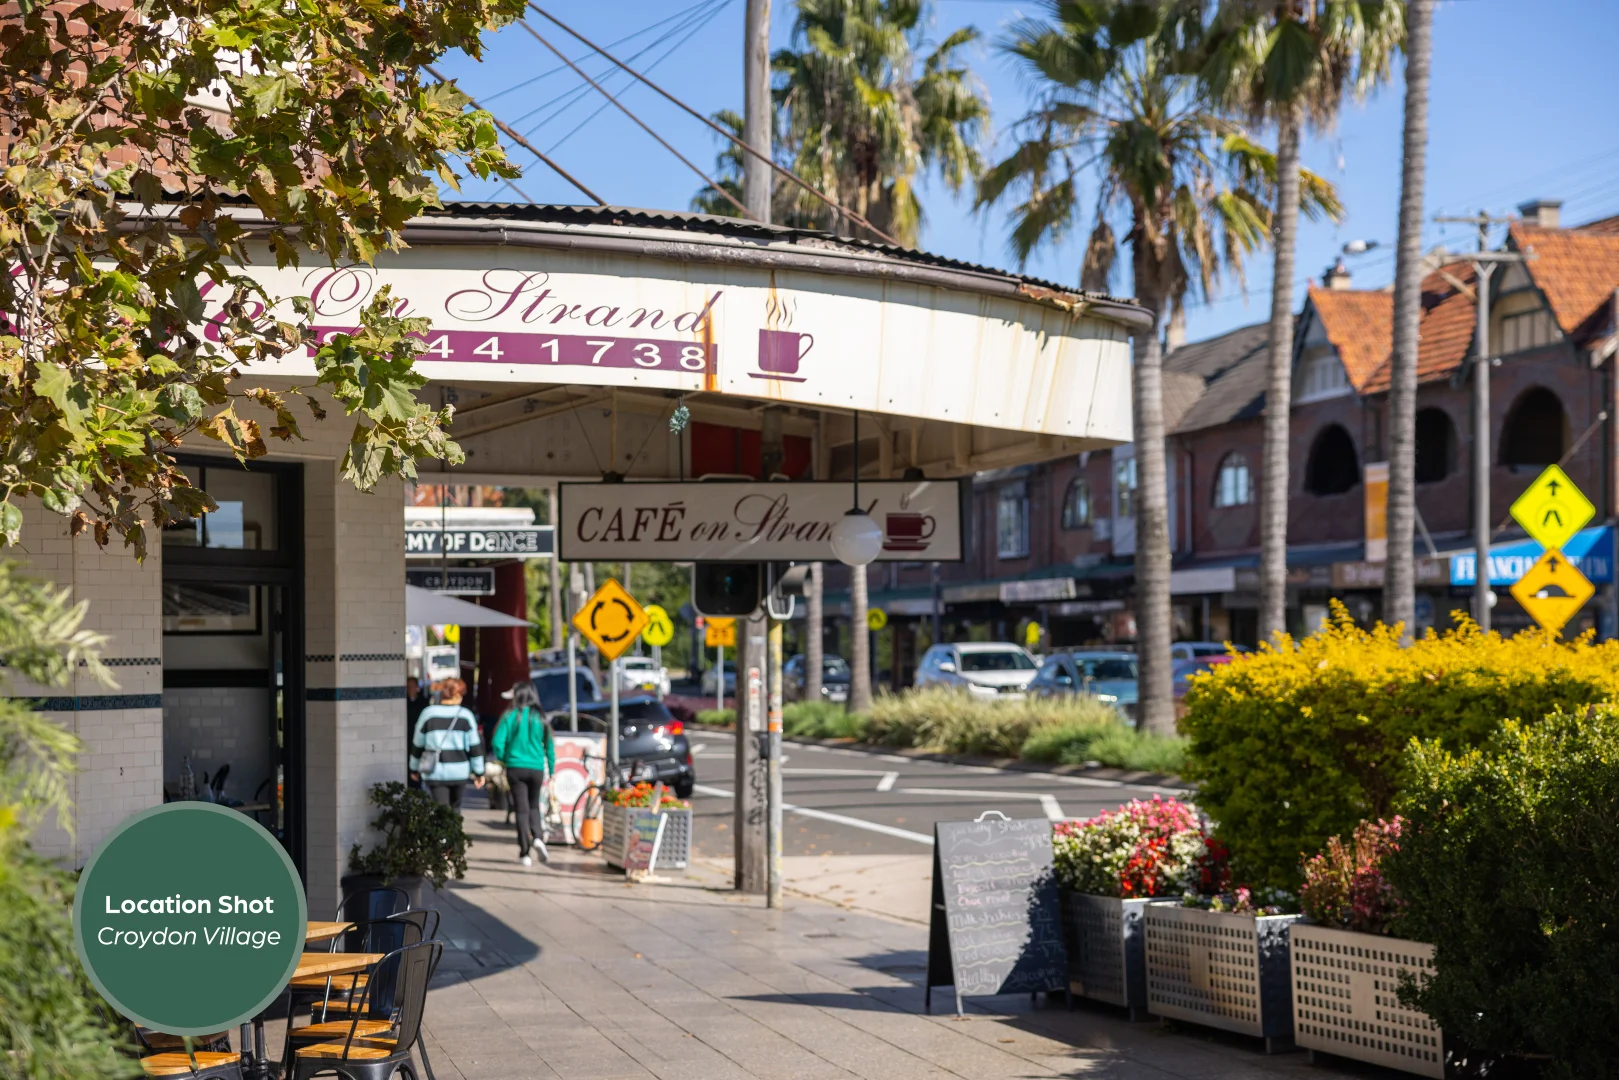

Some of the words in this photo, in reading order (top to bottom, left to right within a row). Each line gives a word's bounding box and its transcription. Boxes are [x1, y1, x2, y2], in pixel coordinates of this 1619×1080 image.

[445, 267, 723, 333] Strand
[540, 338, 707, 371] 1738
[576, 501, 687, 542] CAFÉ
[690, 520, 730, 542] on
[733, 493, 879, 543] Stran
[440, 532, 467, 551] OF
